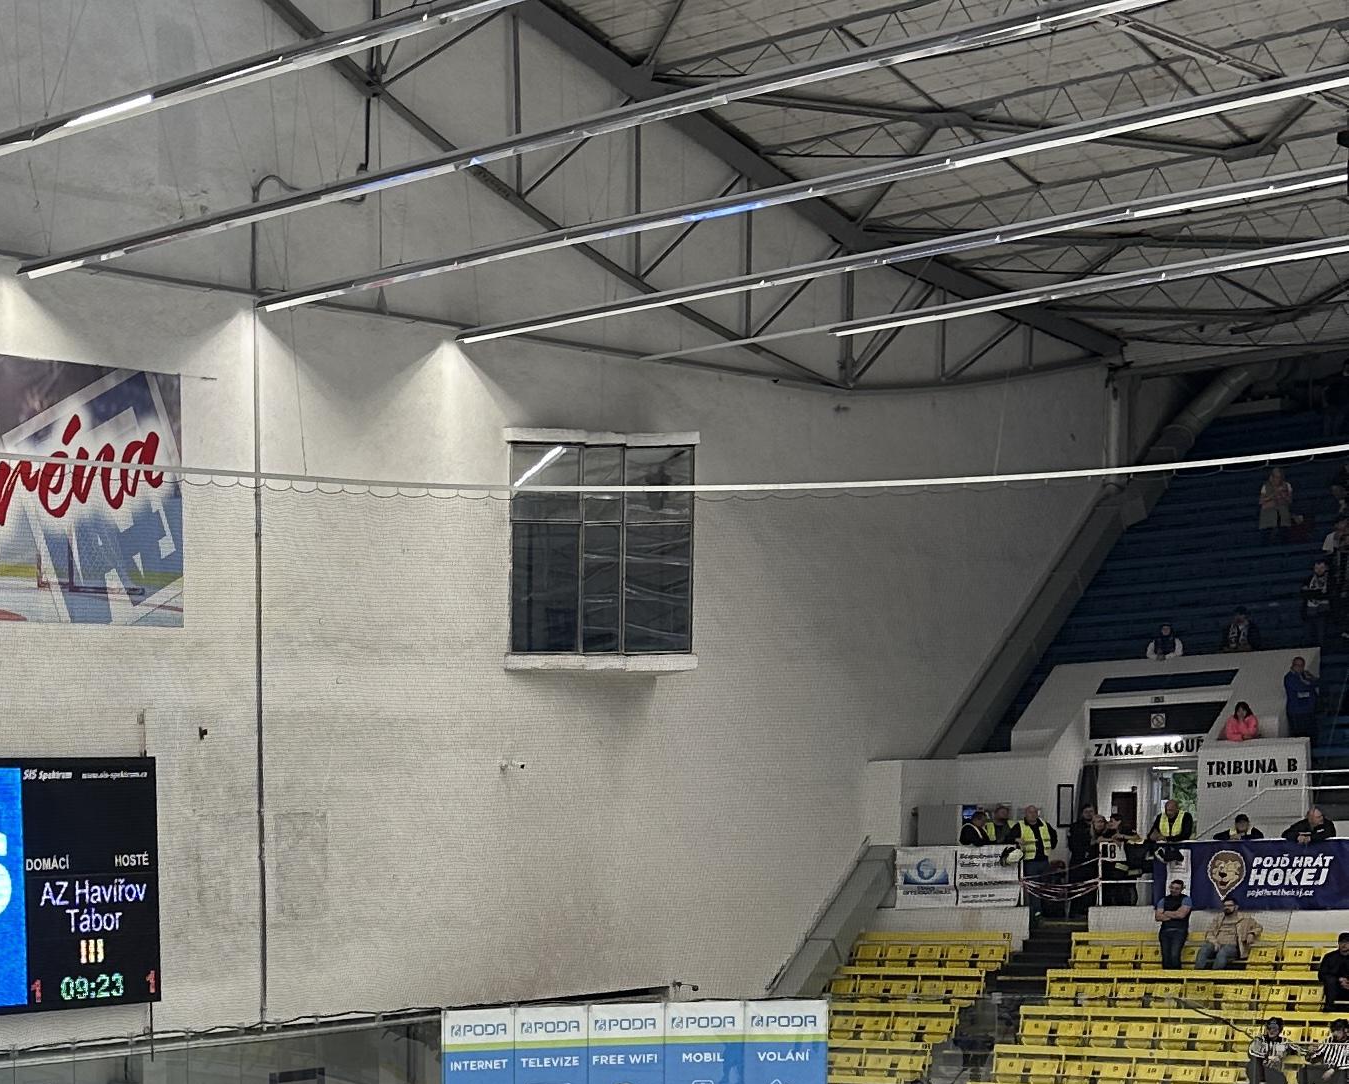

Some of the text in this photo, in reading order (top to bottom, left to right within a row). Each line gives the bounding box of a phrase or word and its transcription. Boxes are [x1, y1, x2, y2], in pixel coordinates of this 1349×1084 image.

[1207, 758, 1298, 775] TRIBUNA B
[25, 854, 69, 871] DOMÁCÍ
[114, 851, 149, 867] HOSTÉ
[1253, 852, 1334, 868] POJĎ HRÁT
[1248, 868, 1330, 886] HOKEJ
[40, 878, 147, 906] AZ Havířov
[65, 908, 123, 933] Tábor
[60, 973, 124, 1000] 09:23
[146, 970, 156, 993] 1
[31, 979, 42, 1003] 1
[534, 1020, 580, 1034] PODA
[608, 1018, 656, 1031] PODA
[686, 1016, 735, 1028] PODA
[766, 1015, 817, 1028] PODA
[463, 1024, 507, 1036] PODA
[521, 1056, 579, 1068] TELEVIZE
[593, 1054, 658, 1065] FREE WIFI
[682, 1052, 724, 1062] MOBIL
[758, 1049, 810, 1062] VOLÁNÍ
[451, 1058, 508, 1071] INTERNET
